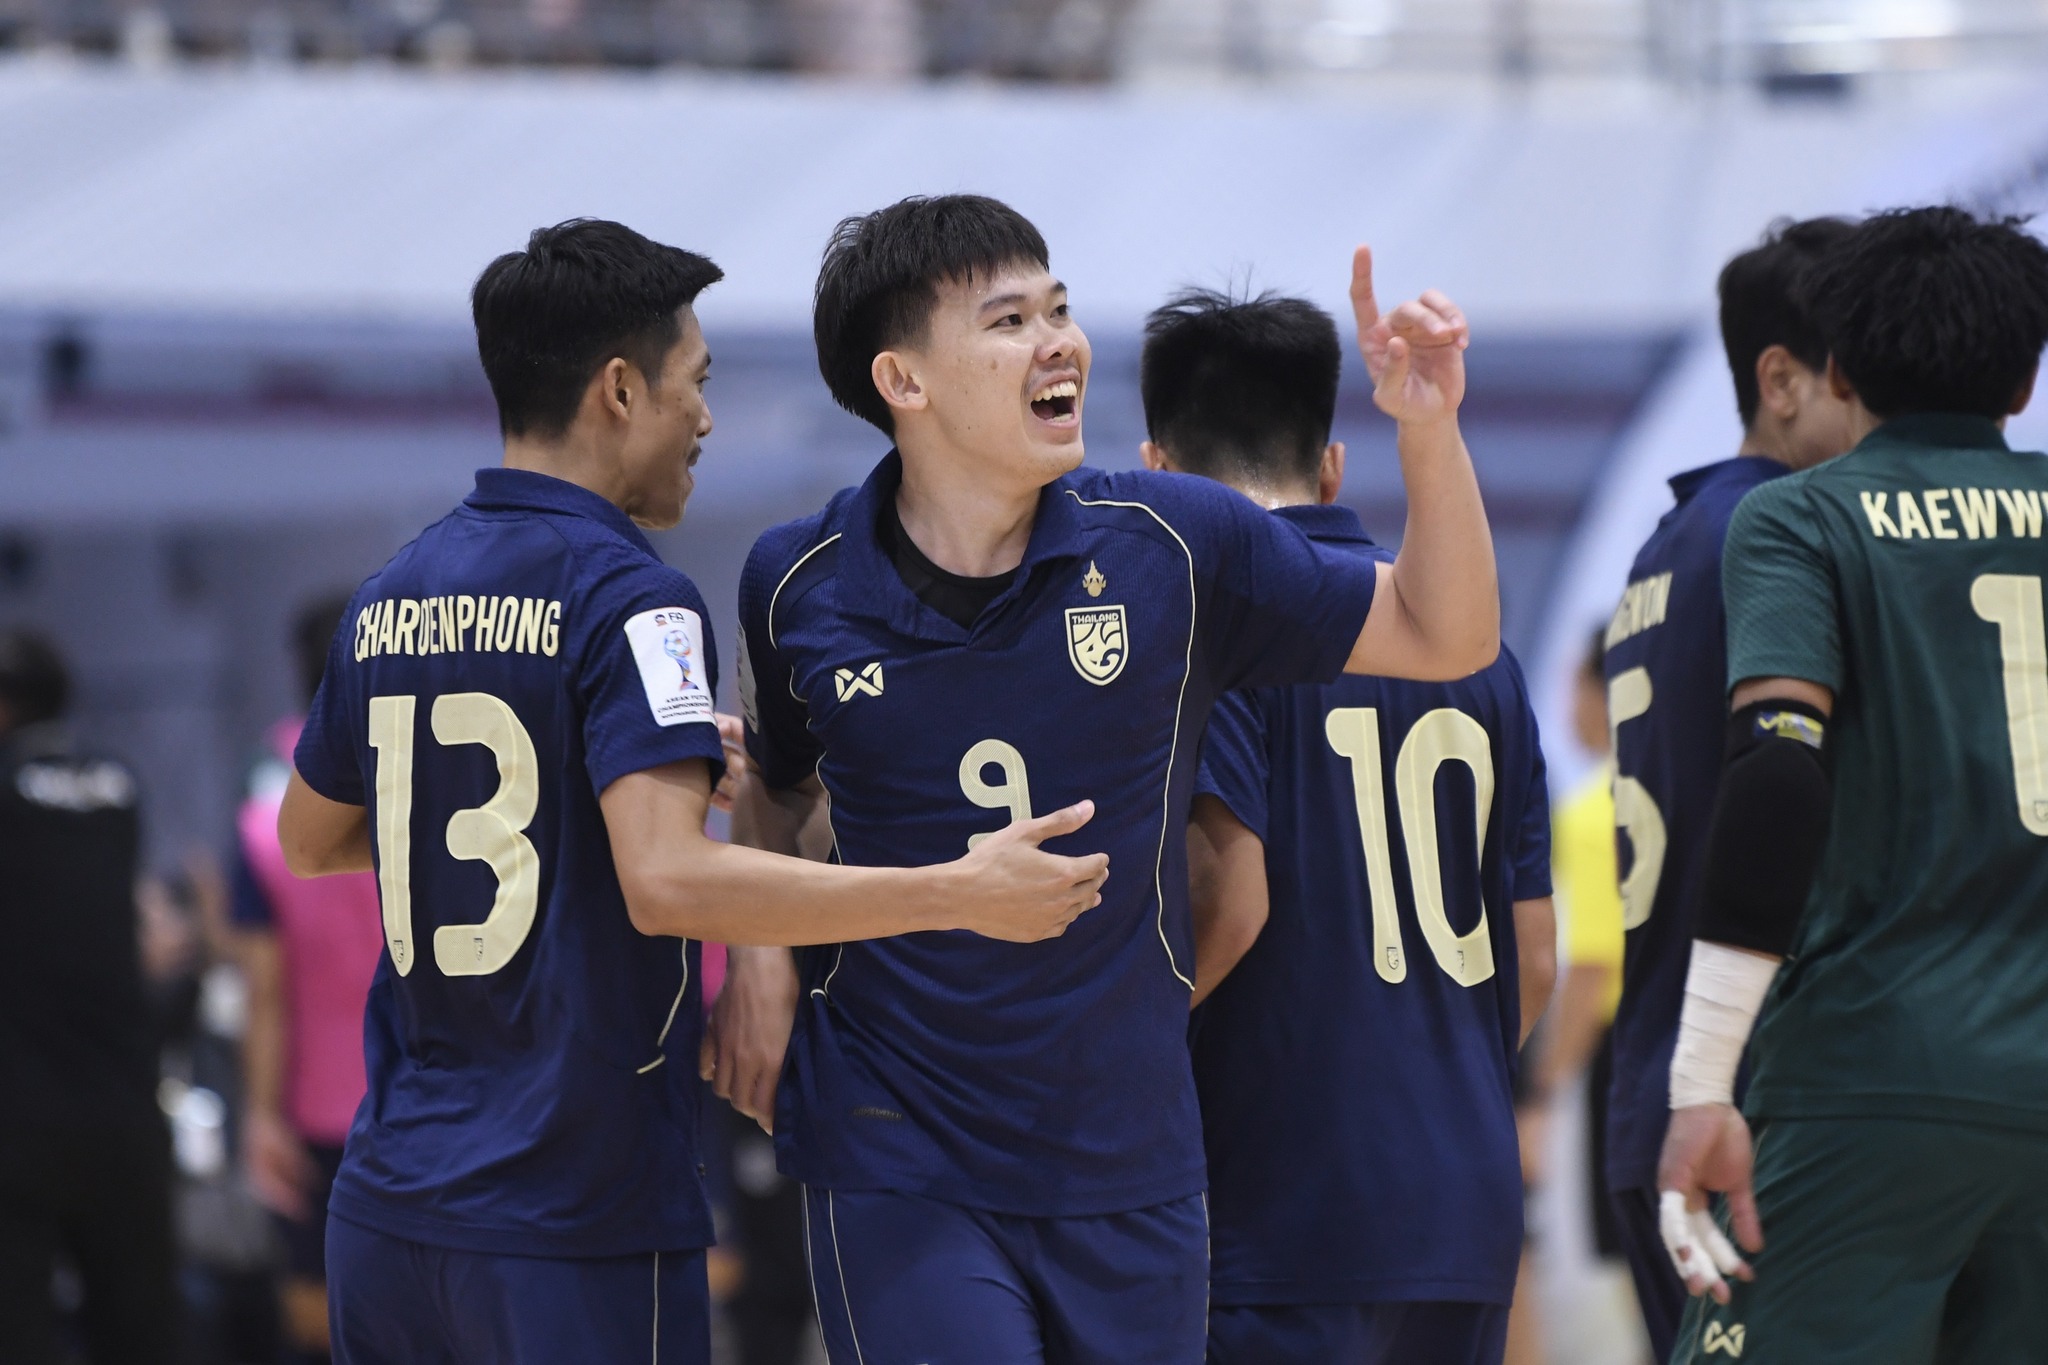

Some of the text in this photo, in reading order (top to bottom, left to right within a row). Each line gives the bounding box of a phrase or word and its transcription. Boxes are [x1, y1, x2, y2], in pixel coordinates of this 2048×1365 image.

[354, 595, 562, 663] CHAROENPHONG
[1071, 612, 1119, 625] THAILAND
[369, 692, 540, 977] 13
[959, 739, 1033, 852] 9
[1325, 707, 1495, 987] 10
